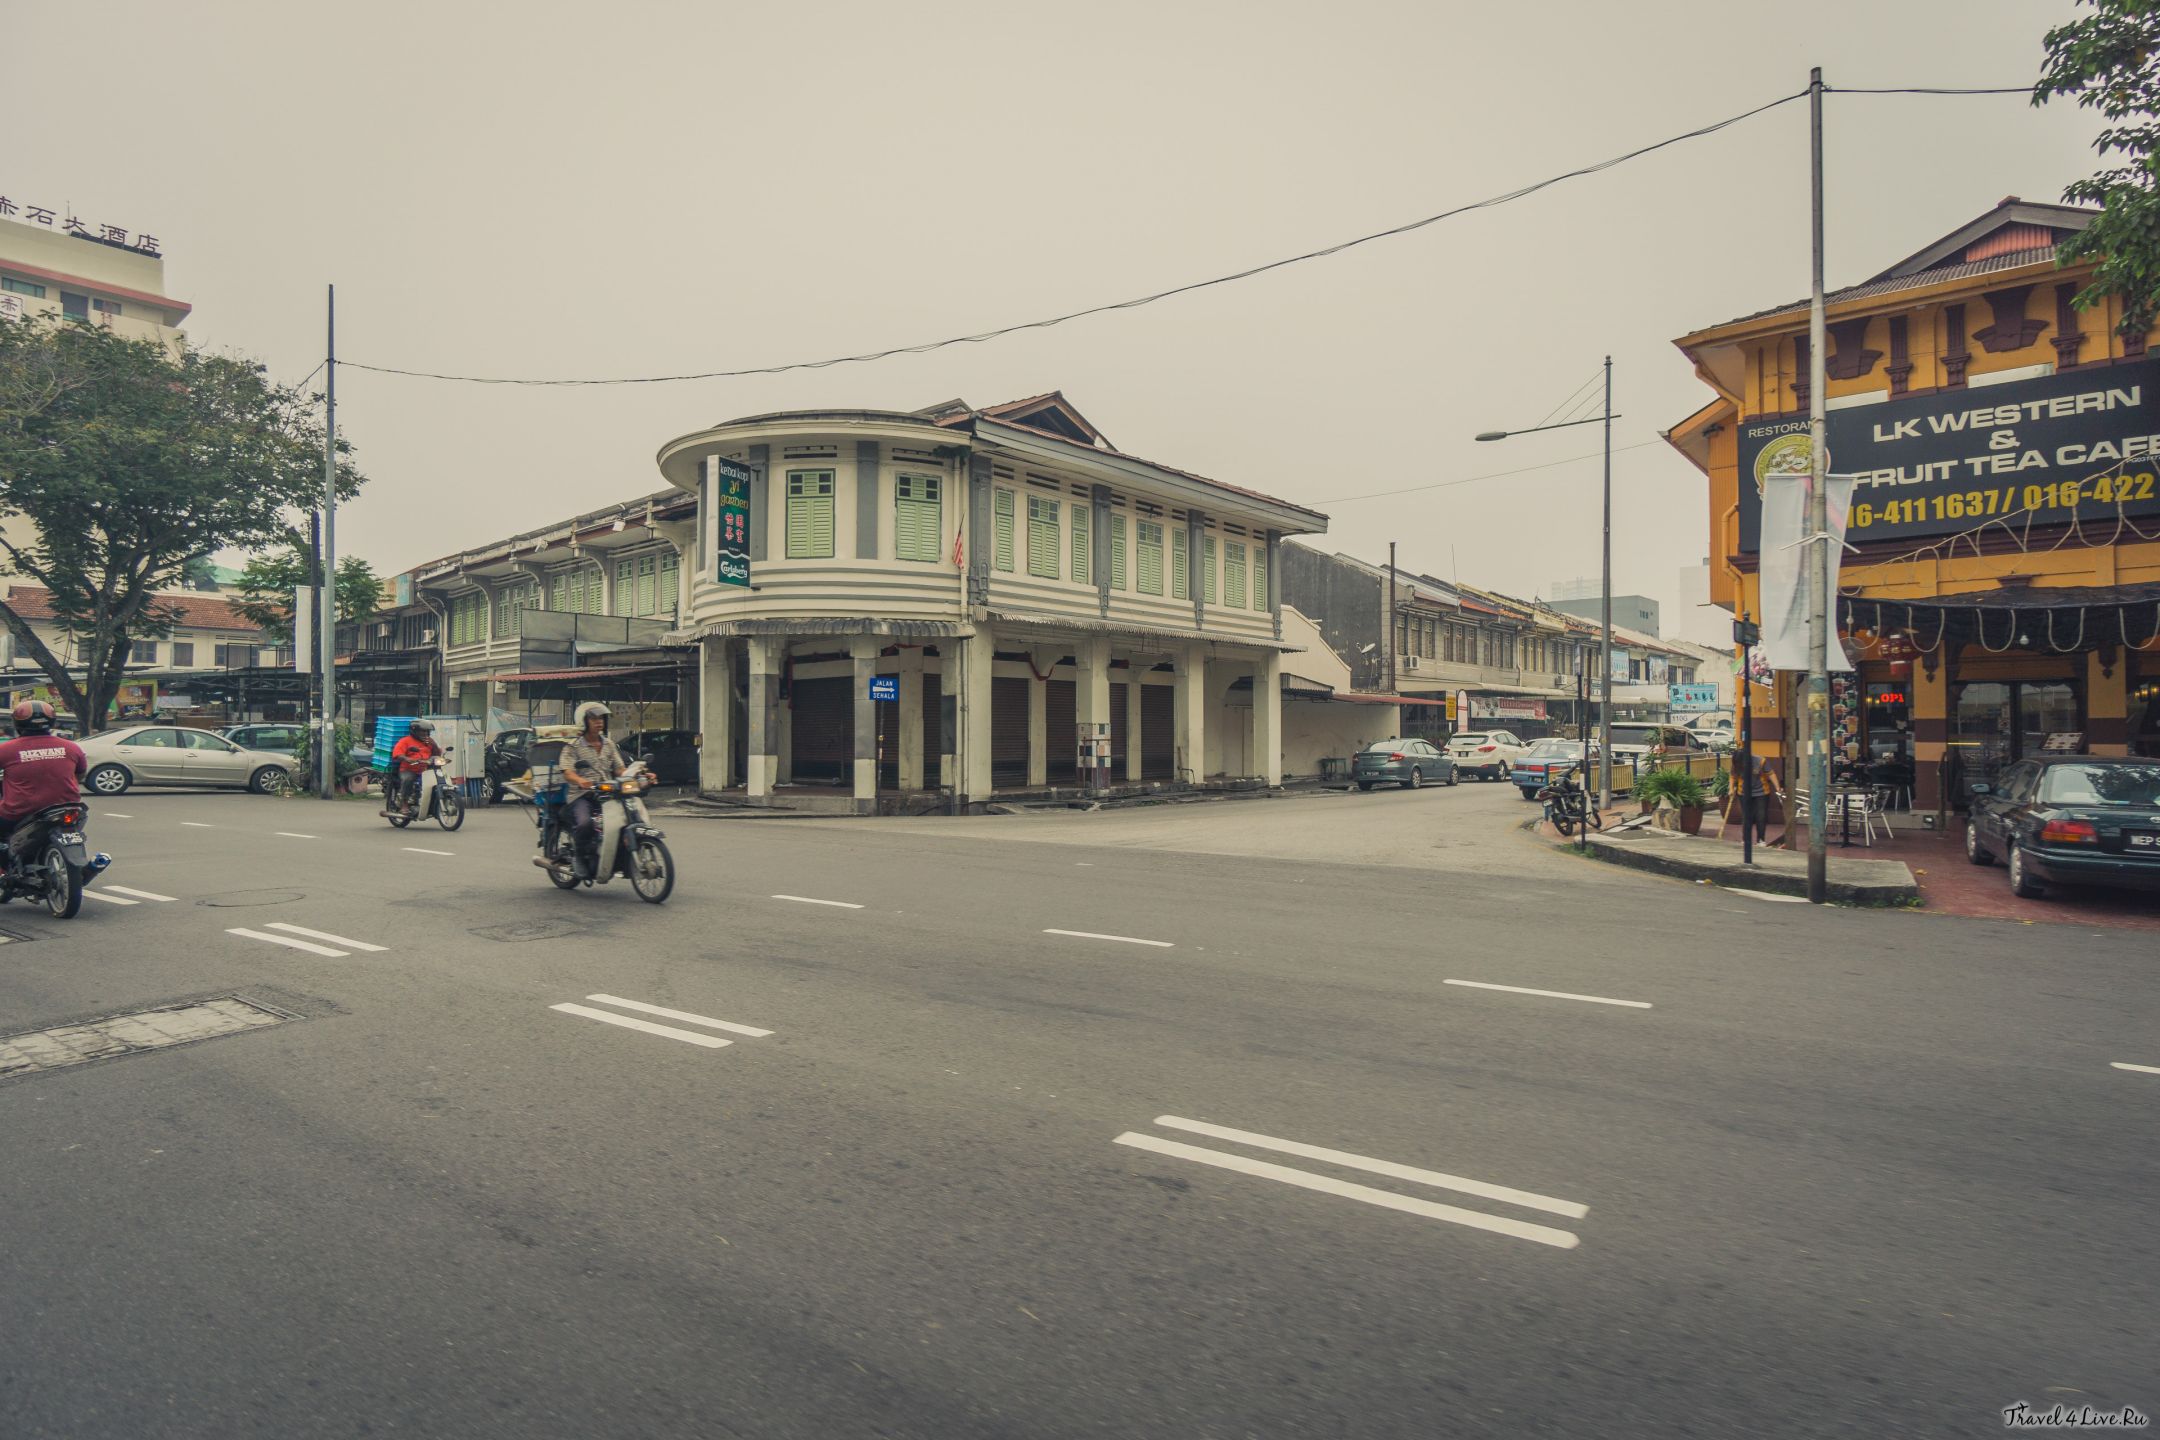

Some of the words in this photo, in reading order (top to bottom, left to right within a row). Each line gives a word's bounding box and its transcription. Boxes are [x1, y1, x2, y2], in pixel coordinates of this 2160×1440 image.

[1873, 418, 1922, 443] LK
[1927, 385, 2141, 433] WESTERN
[1989, 429, 2021, 450] &
[1852, 460, 1958, 490] FRUIT
[1965, 450, 2049, 476] TEA
[1846, 496, 1926, 528] 16-411
[720, 561, 748, 578] Carlsberg
